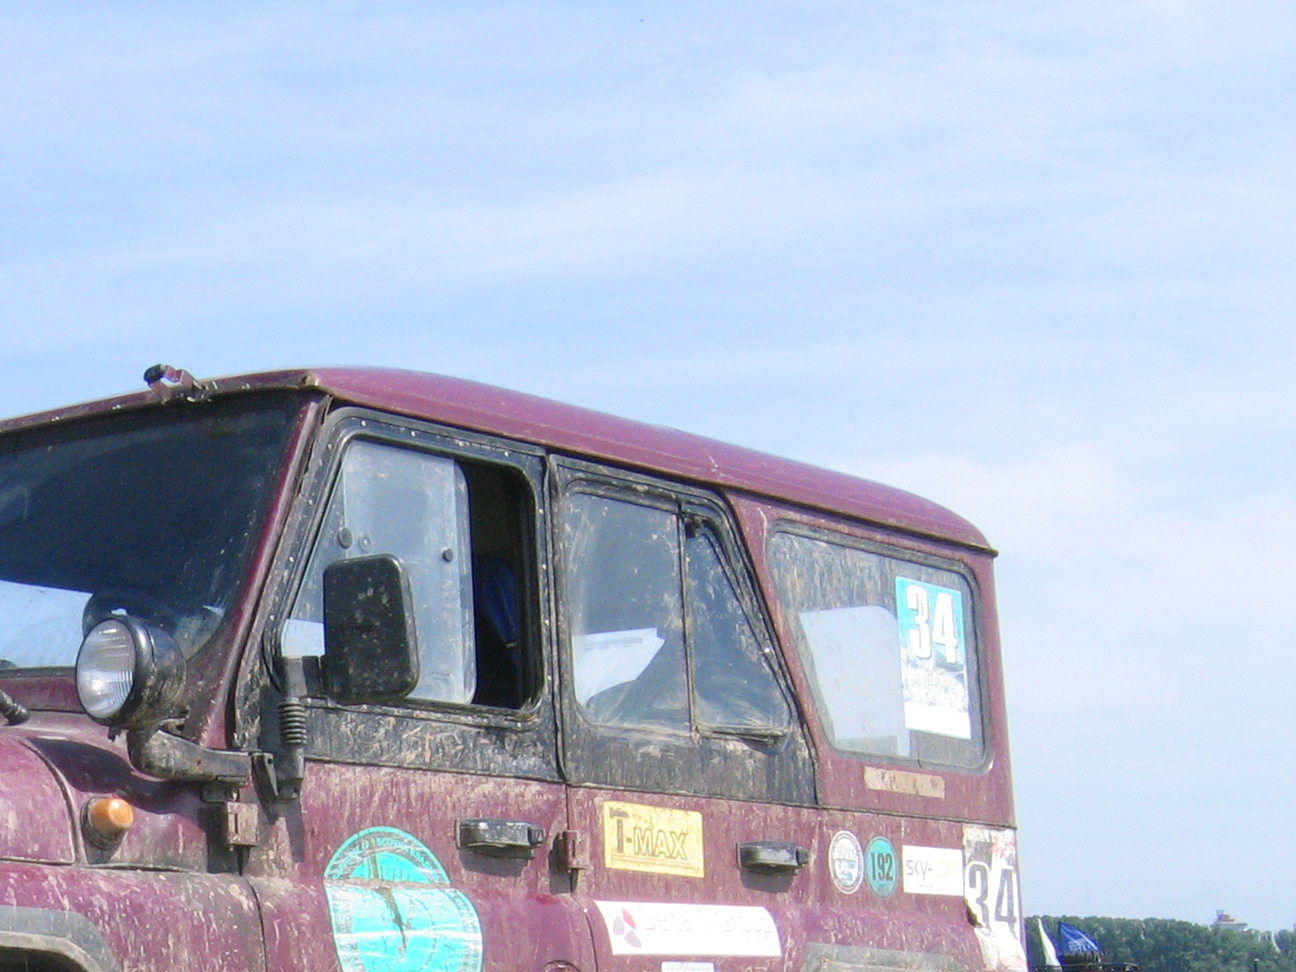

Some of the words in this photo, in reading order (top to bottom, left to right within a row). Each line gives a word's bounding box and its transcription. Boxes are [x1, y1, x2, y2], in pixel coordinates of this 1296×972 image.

[906, 584, 958, 665] 34
[609, 807, 688, 861] T-MAX
[871, 852, 894, 881] 192
[968, 863, 1019, 936] 34
